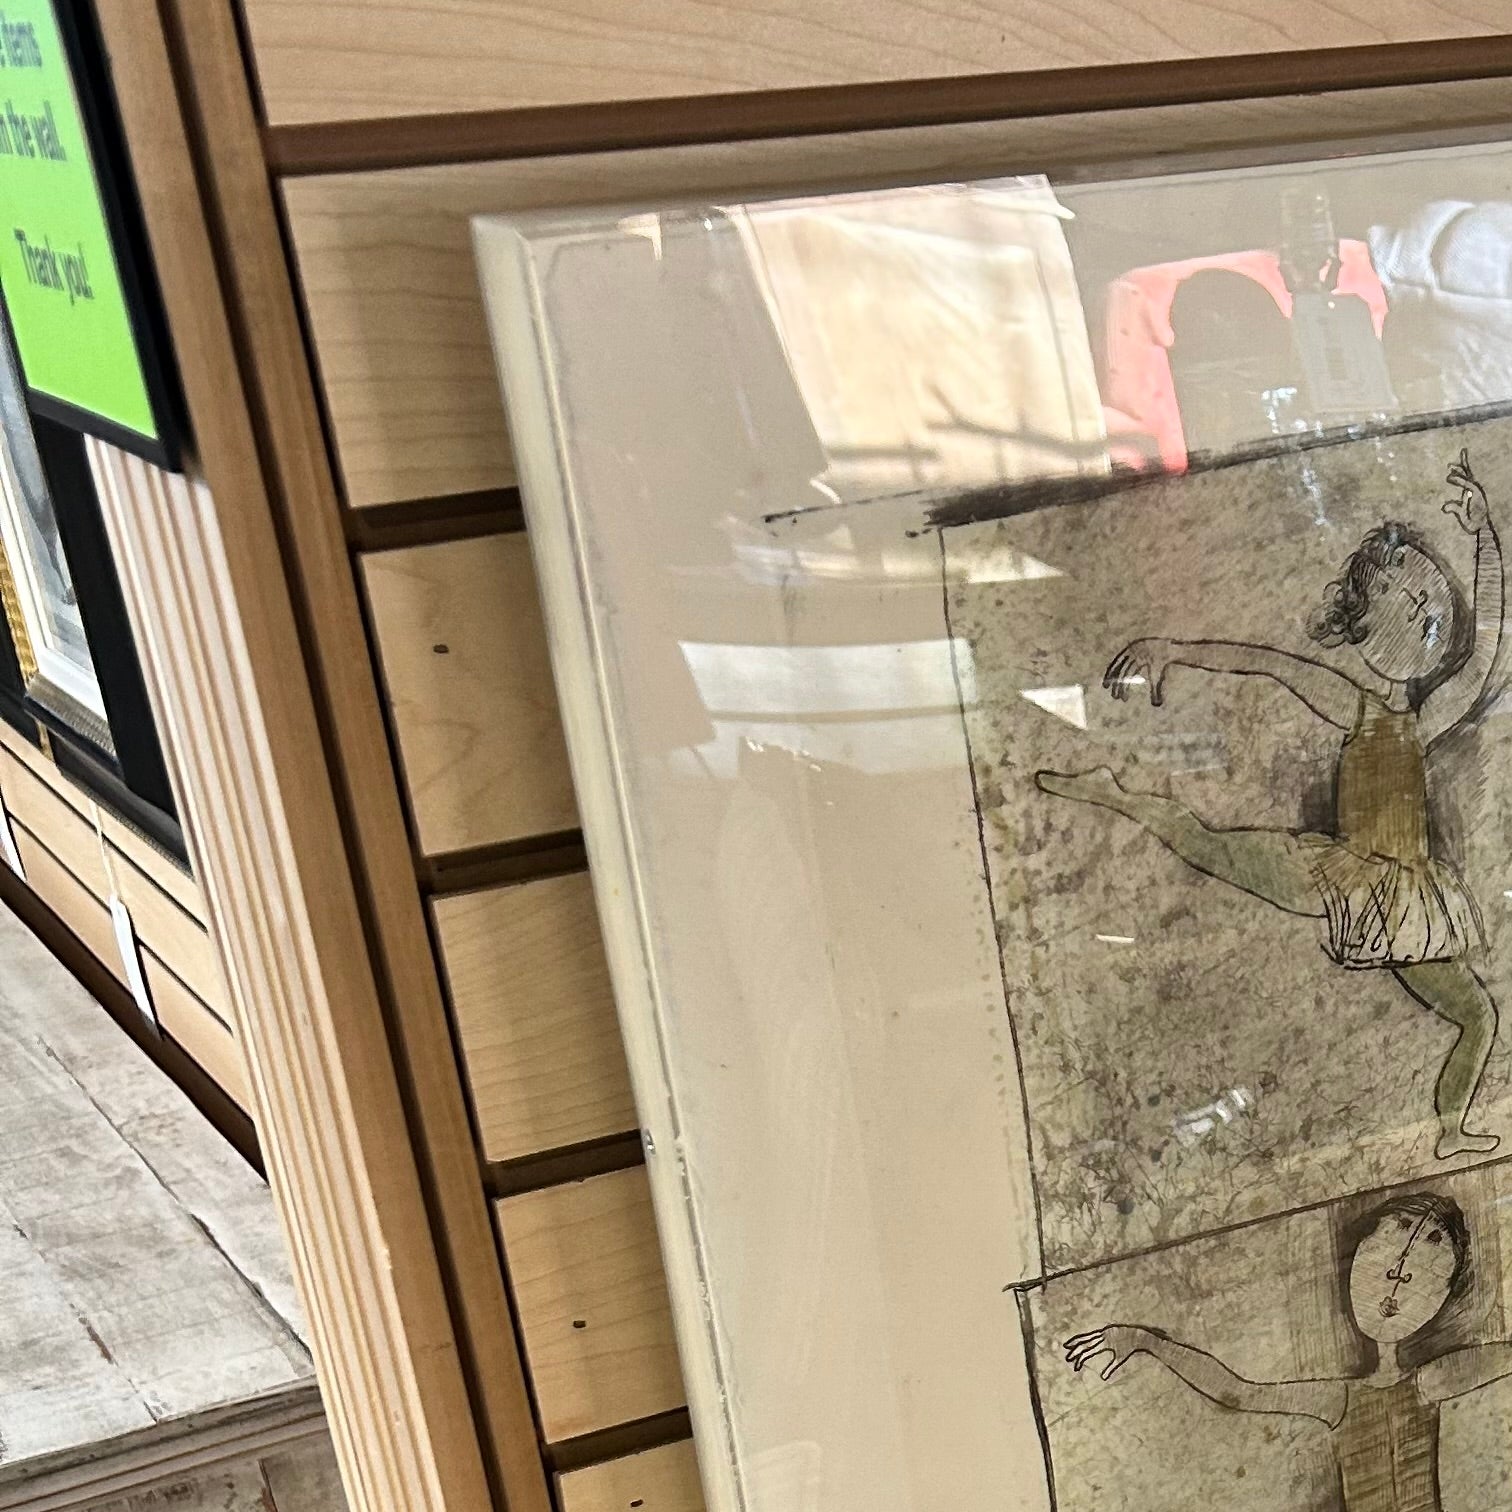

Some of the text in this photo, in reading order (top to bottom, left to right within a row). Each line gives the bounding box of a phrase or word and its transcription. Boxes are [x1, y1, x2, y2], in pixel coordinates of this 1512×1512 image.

[5, 99, 35, 157] the
[14, 227, 95, 306] Thank you!
